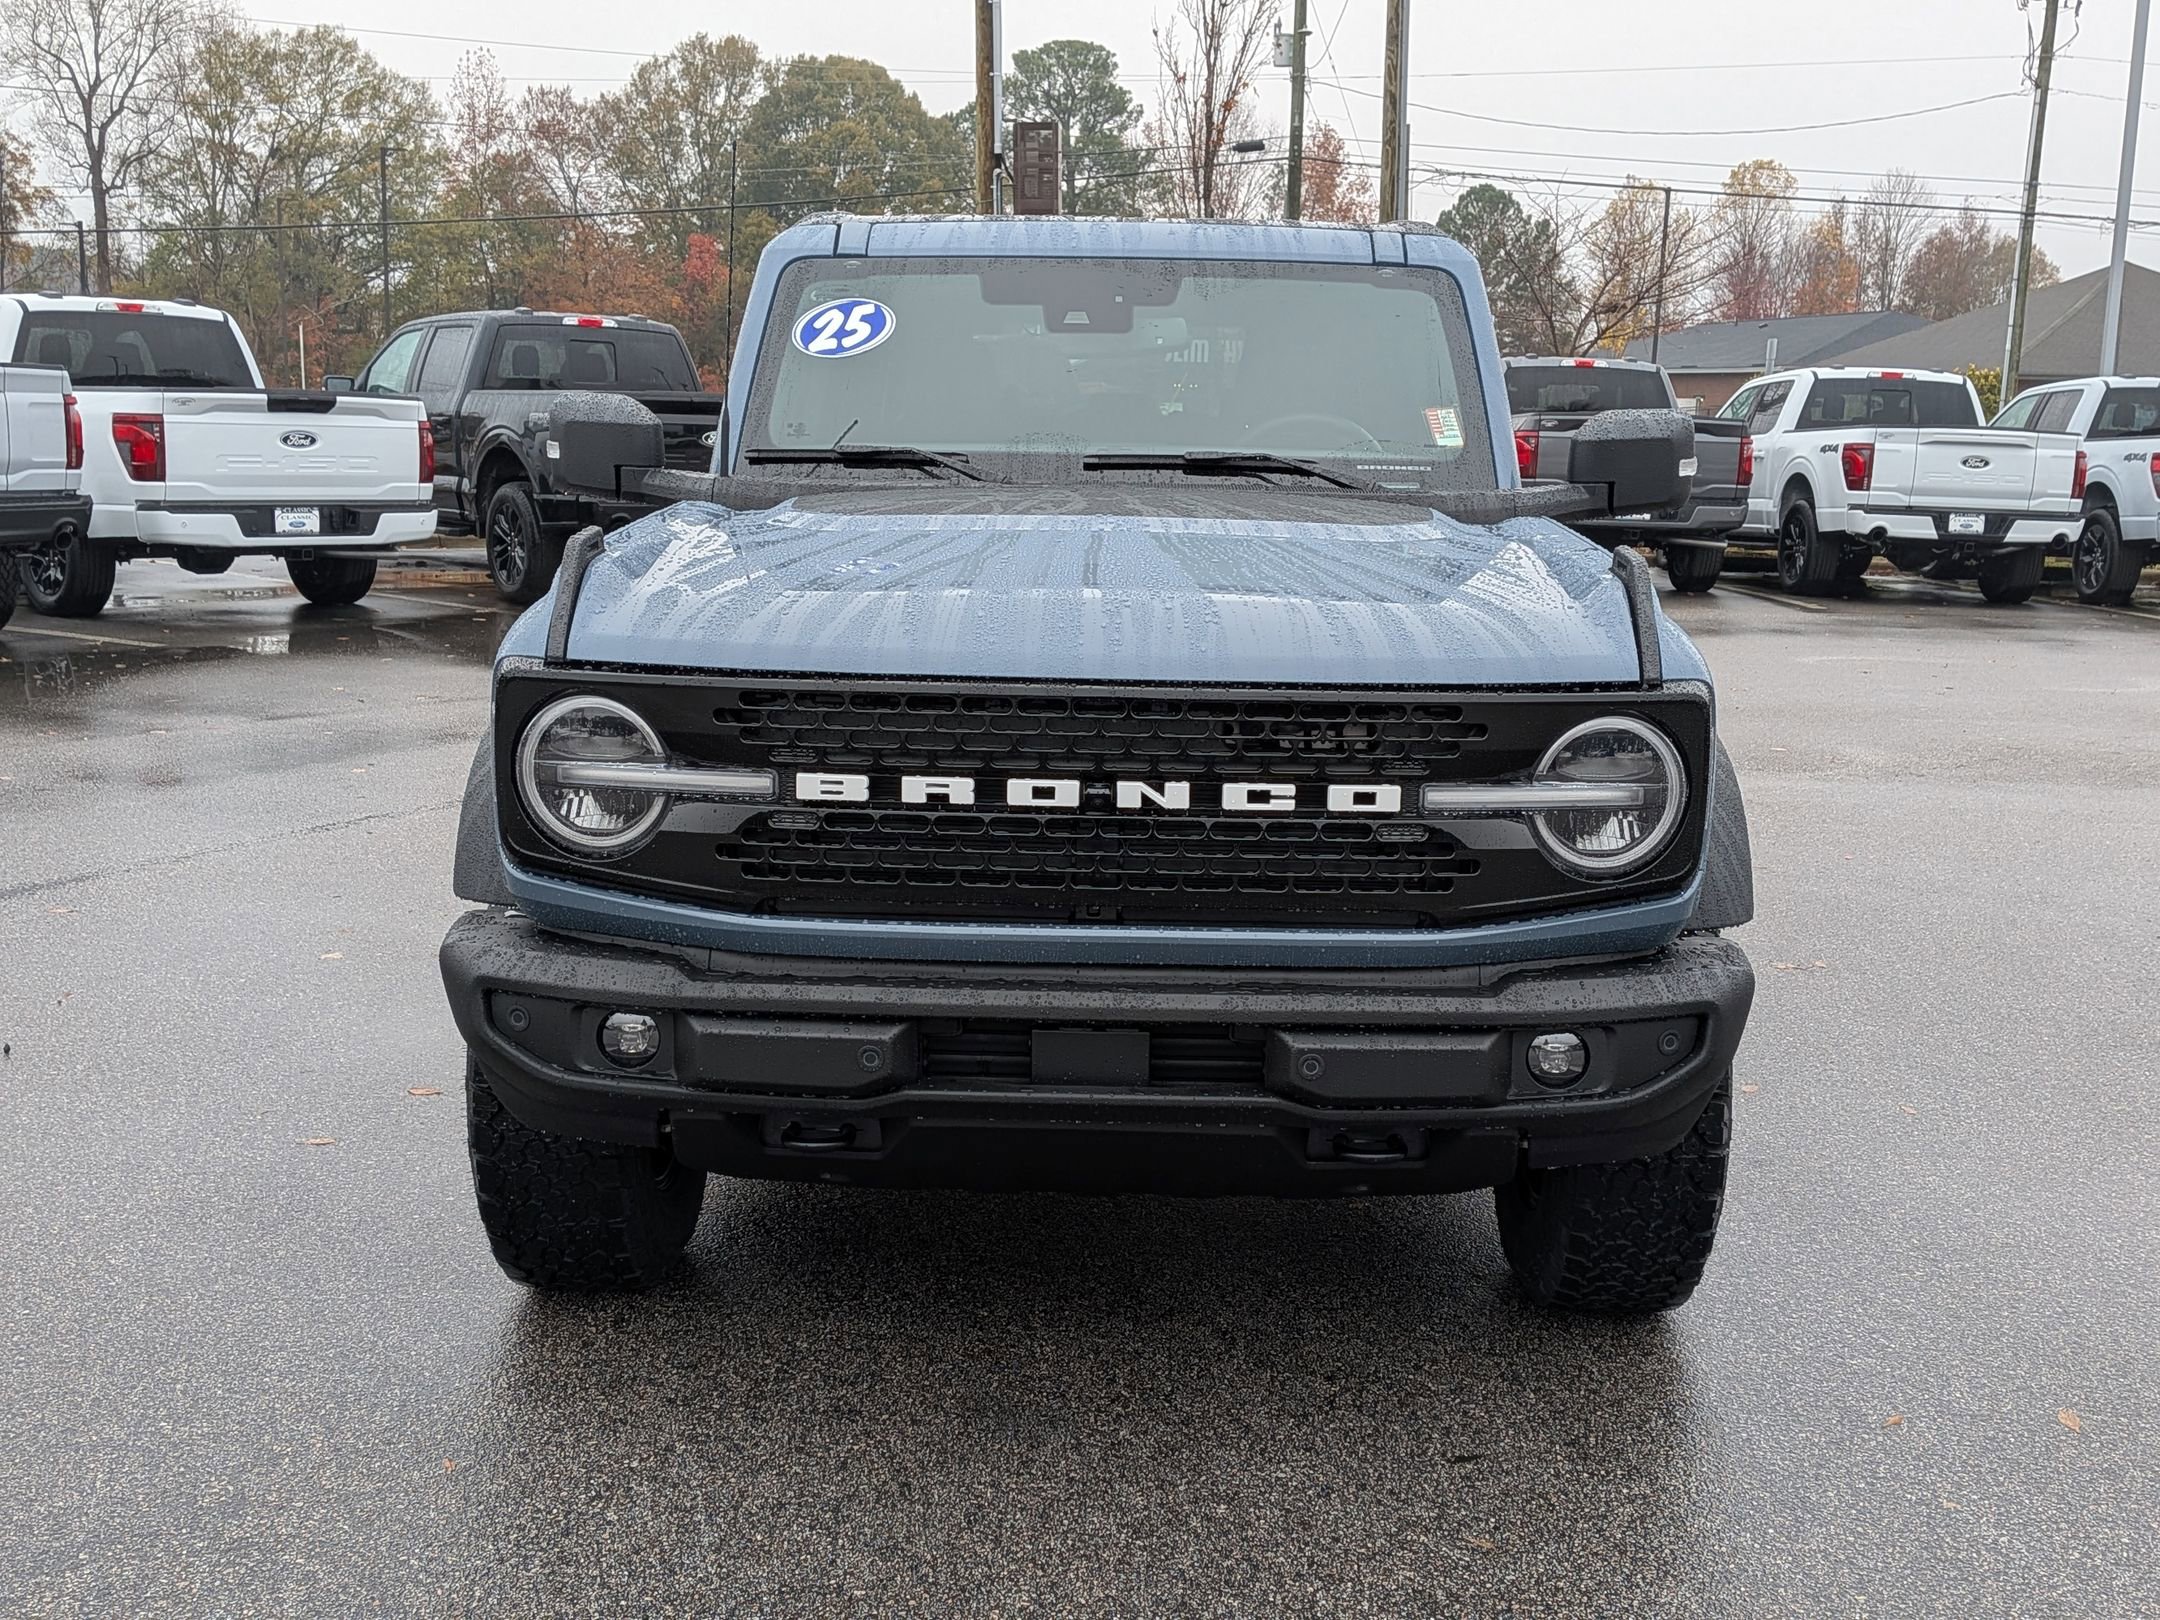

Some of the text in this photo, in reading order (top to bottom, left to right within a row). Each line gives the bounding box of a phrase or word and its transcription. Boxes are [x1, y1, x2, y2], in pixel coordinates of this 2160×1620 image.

[807, 303, 875, 352] 25
[286, 432, 313, 447] Ford
[795, 771, 1402, 813] BRONCO
